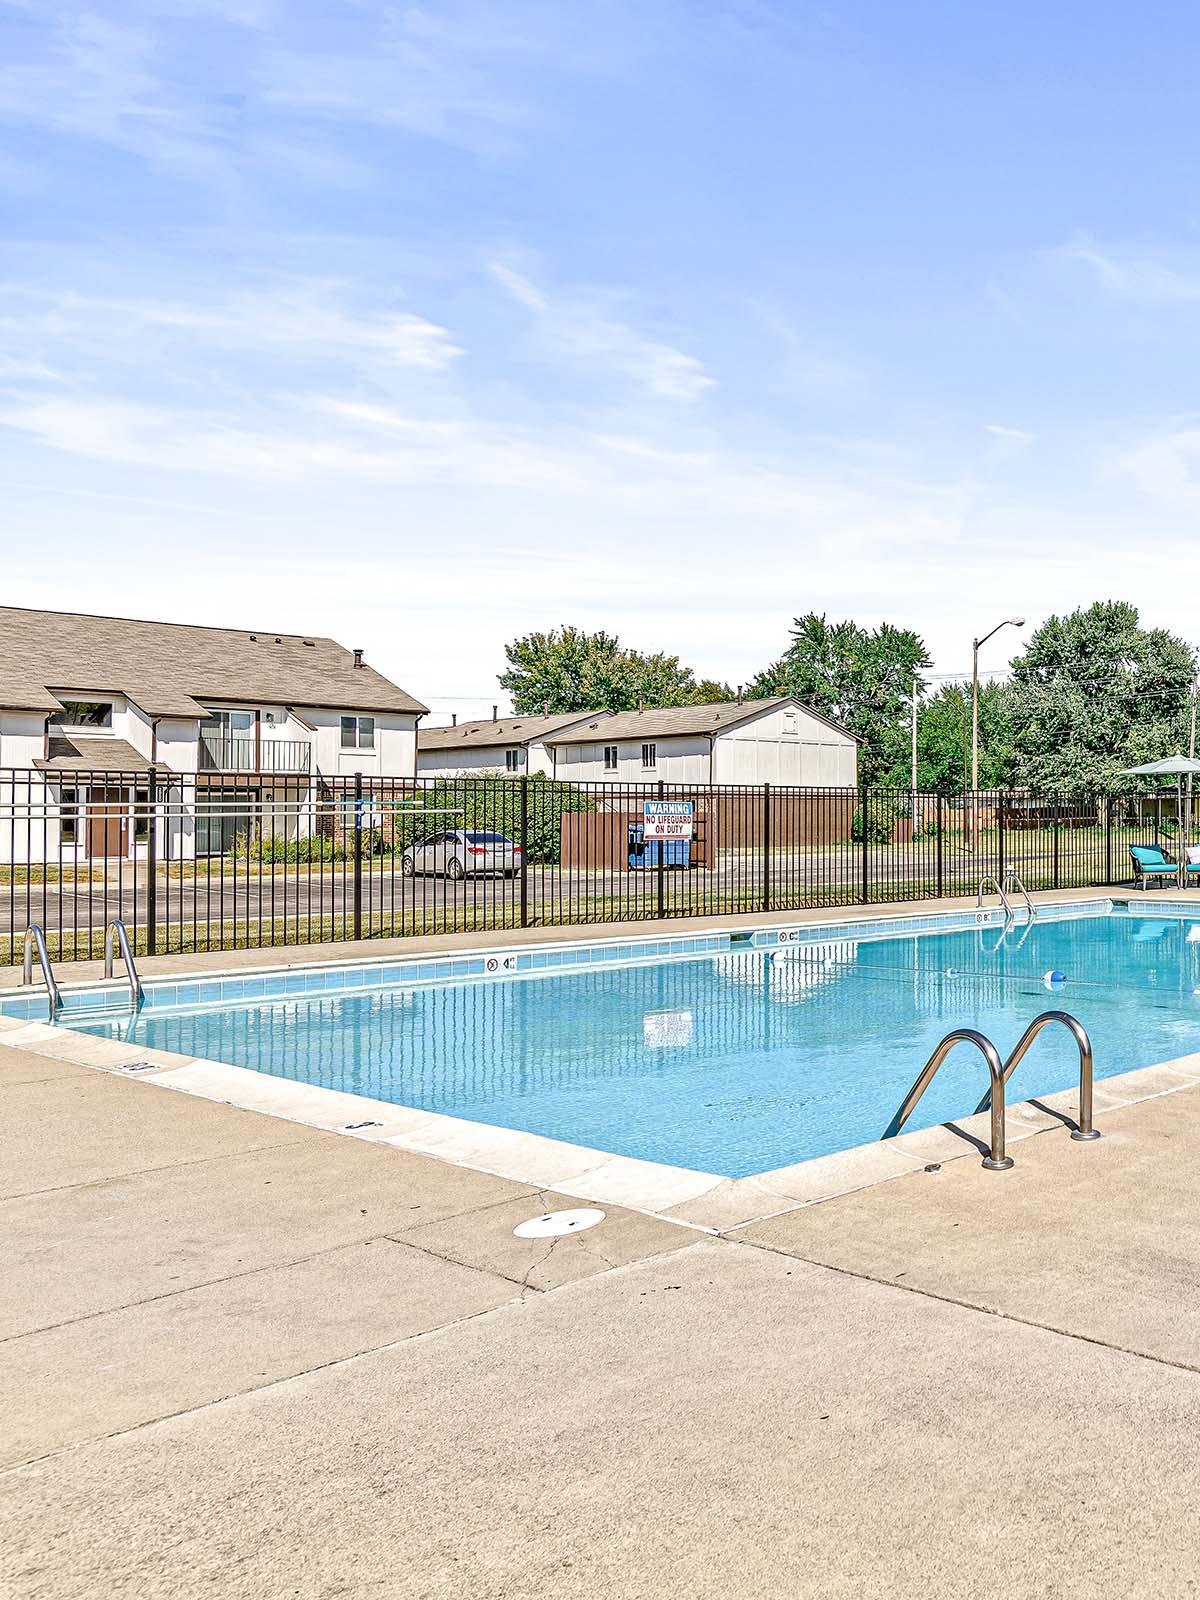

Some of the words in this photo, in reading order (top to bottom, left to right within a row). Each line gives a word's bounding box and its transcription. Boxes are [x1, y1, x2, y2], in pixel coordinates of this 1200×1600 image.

[648, 803, 689, 814] WARNING
[646, 816, 656, 824] NO
[658, 816, 691, 824] LIFEGUARD
[656, 825, 665, 834] ON
[667, 825, 683, 834] DUTY
